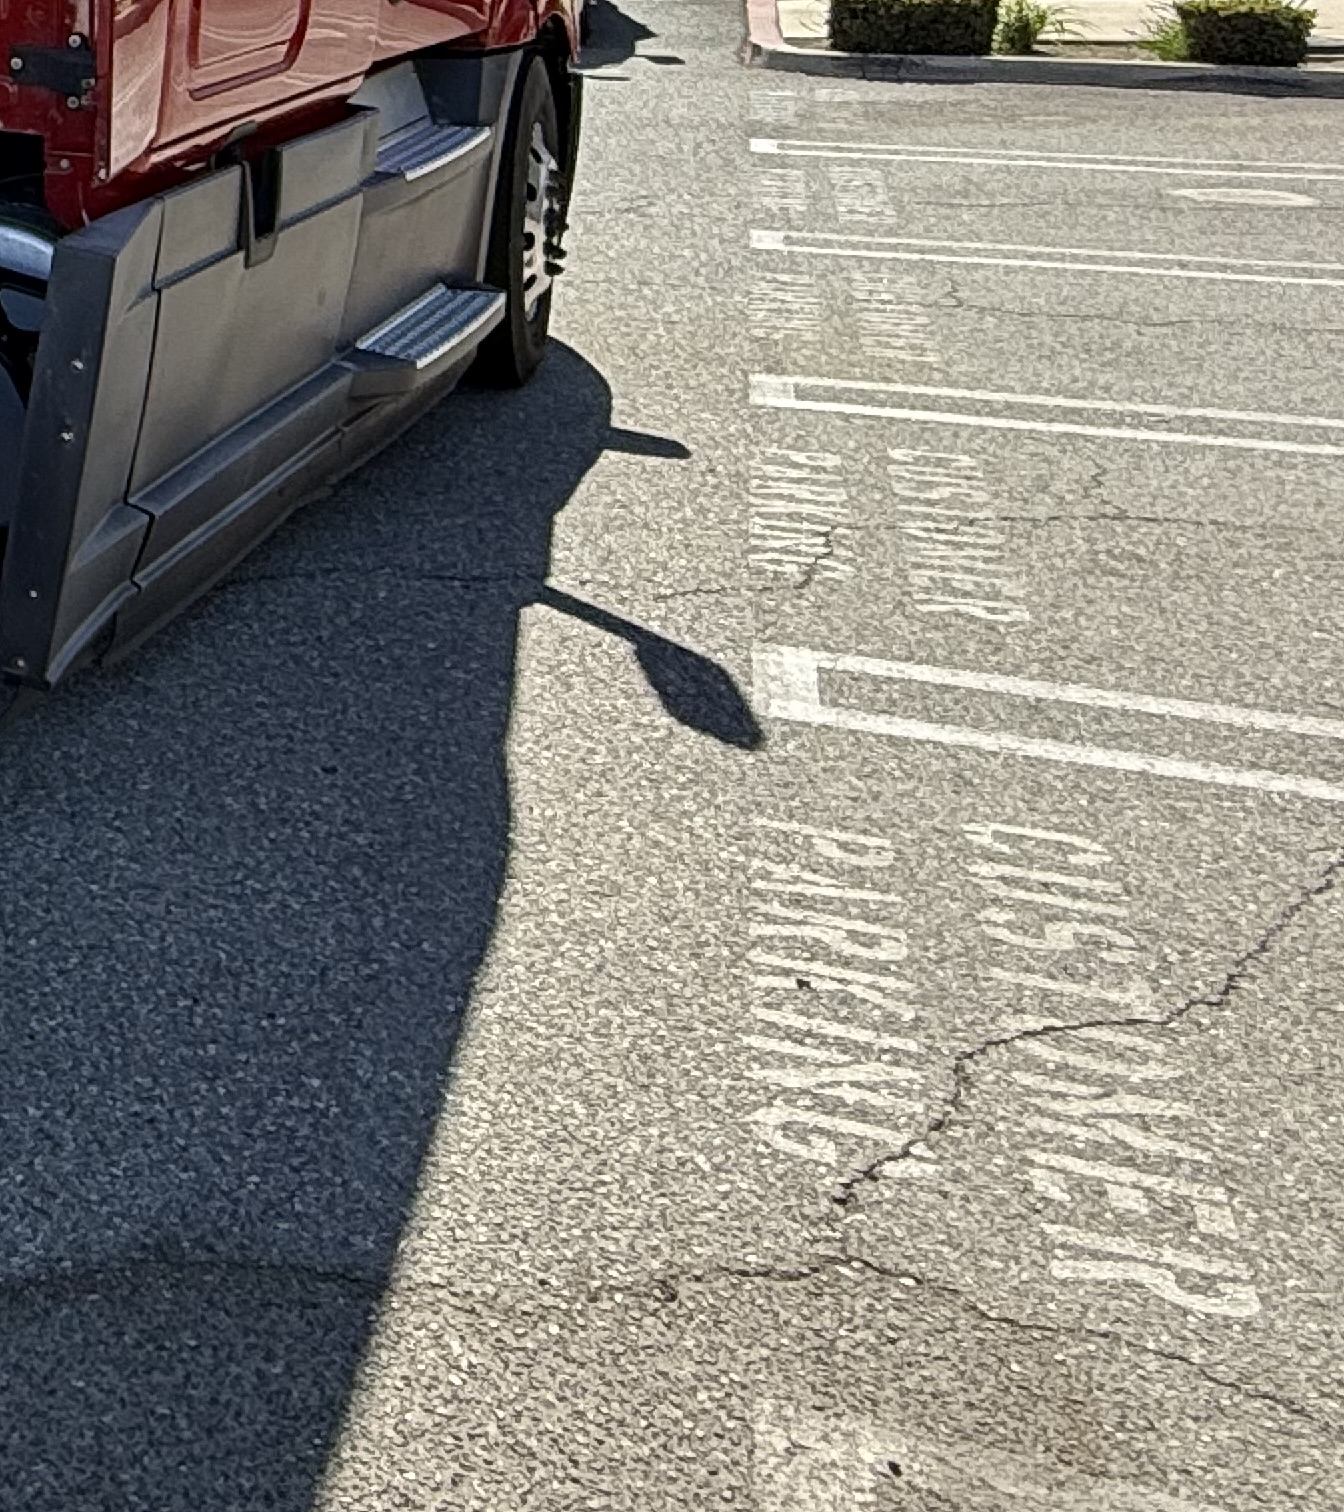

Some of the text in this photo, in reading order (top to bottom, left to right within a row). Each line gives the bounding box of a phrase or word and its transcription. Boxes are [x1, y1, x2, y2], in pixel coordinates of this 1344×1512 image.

[749, 449, 854, 579] PARKING
[888, 448, 1030, 621] CUSTOMER
[744, 819, 939, 1178] PARKING
[963, 823, 1261, 1316] CUSTOMER
